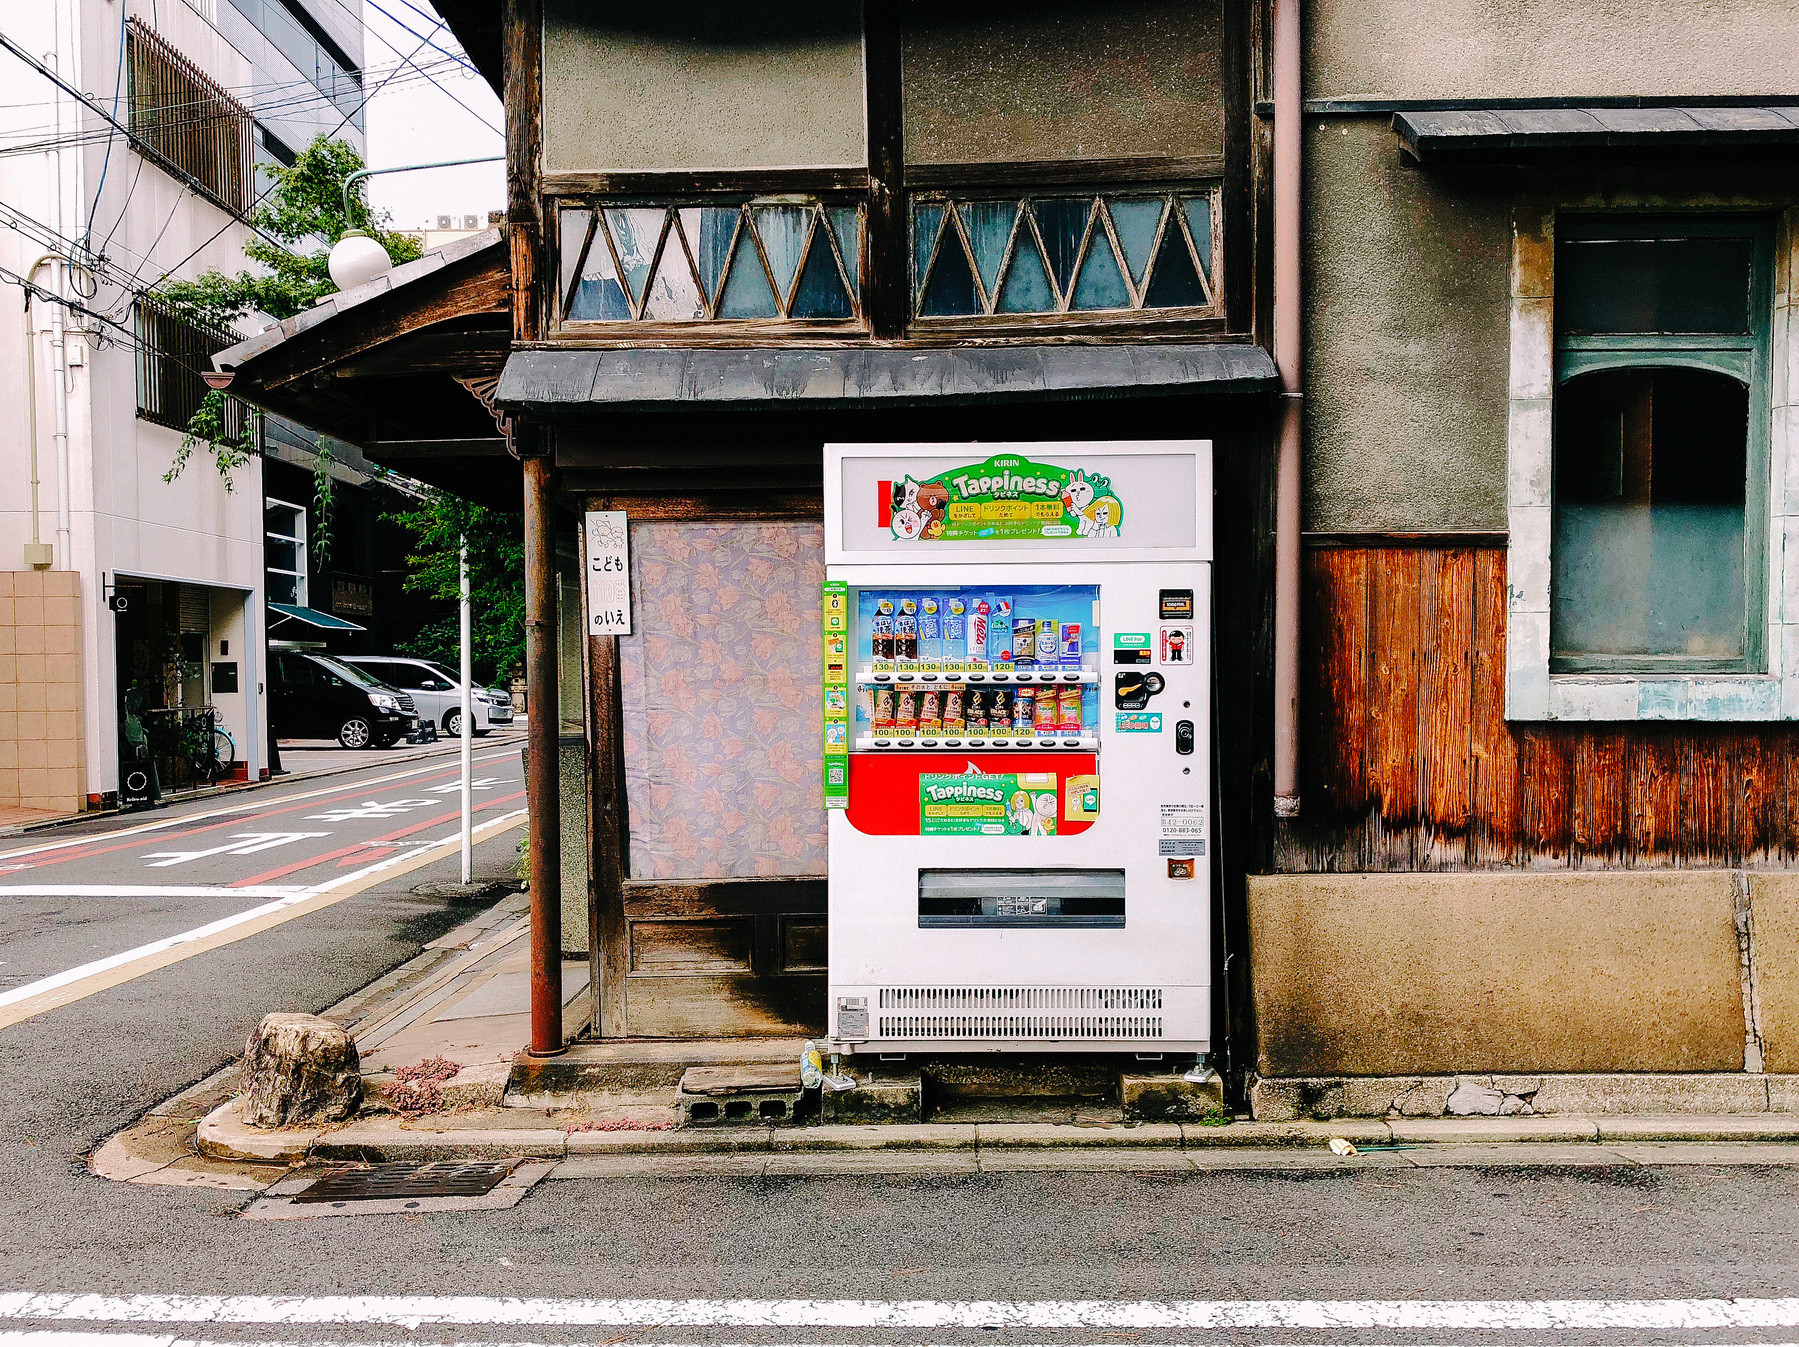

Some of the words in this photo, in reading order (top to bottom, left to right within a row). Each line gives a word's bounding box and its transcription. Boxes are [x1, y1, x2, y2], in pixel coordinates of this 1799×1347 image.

[994, 459, 1019, 467] KIRIN
[952, 470, 1060, 498] Tappiness
[983, 504, 1028, 512] ドリンクポイント
[592, 556, 624, 572] こども
[594, 609, 625, 626] のいえ
[926, 781, 1004, 802] Tappiness
